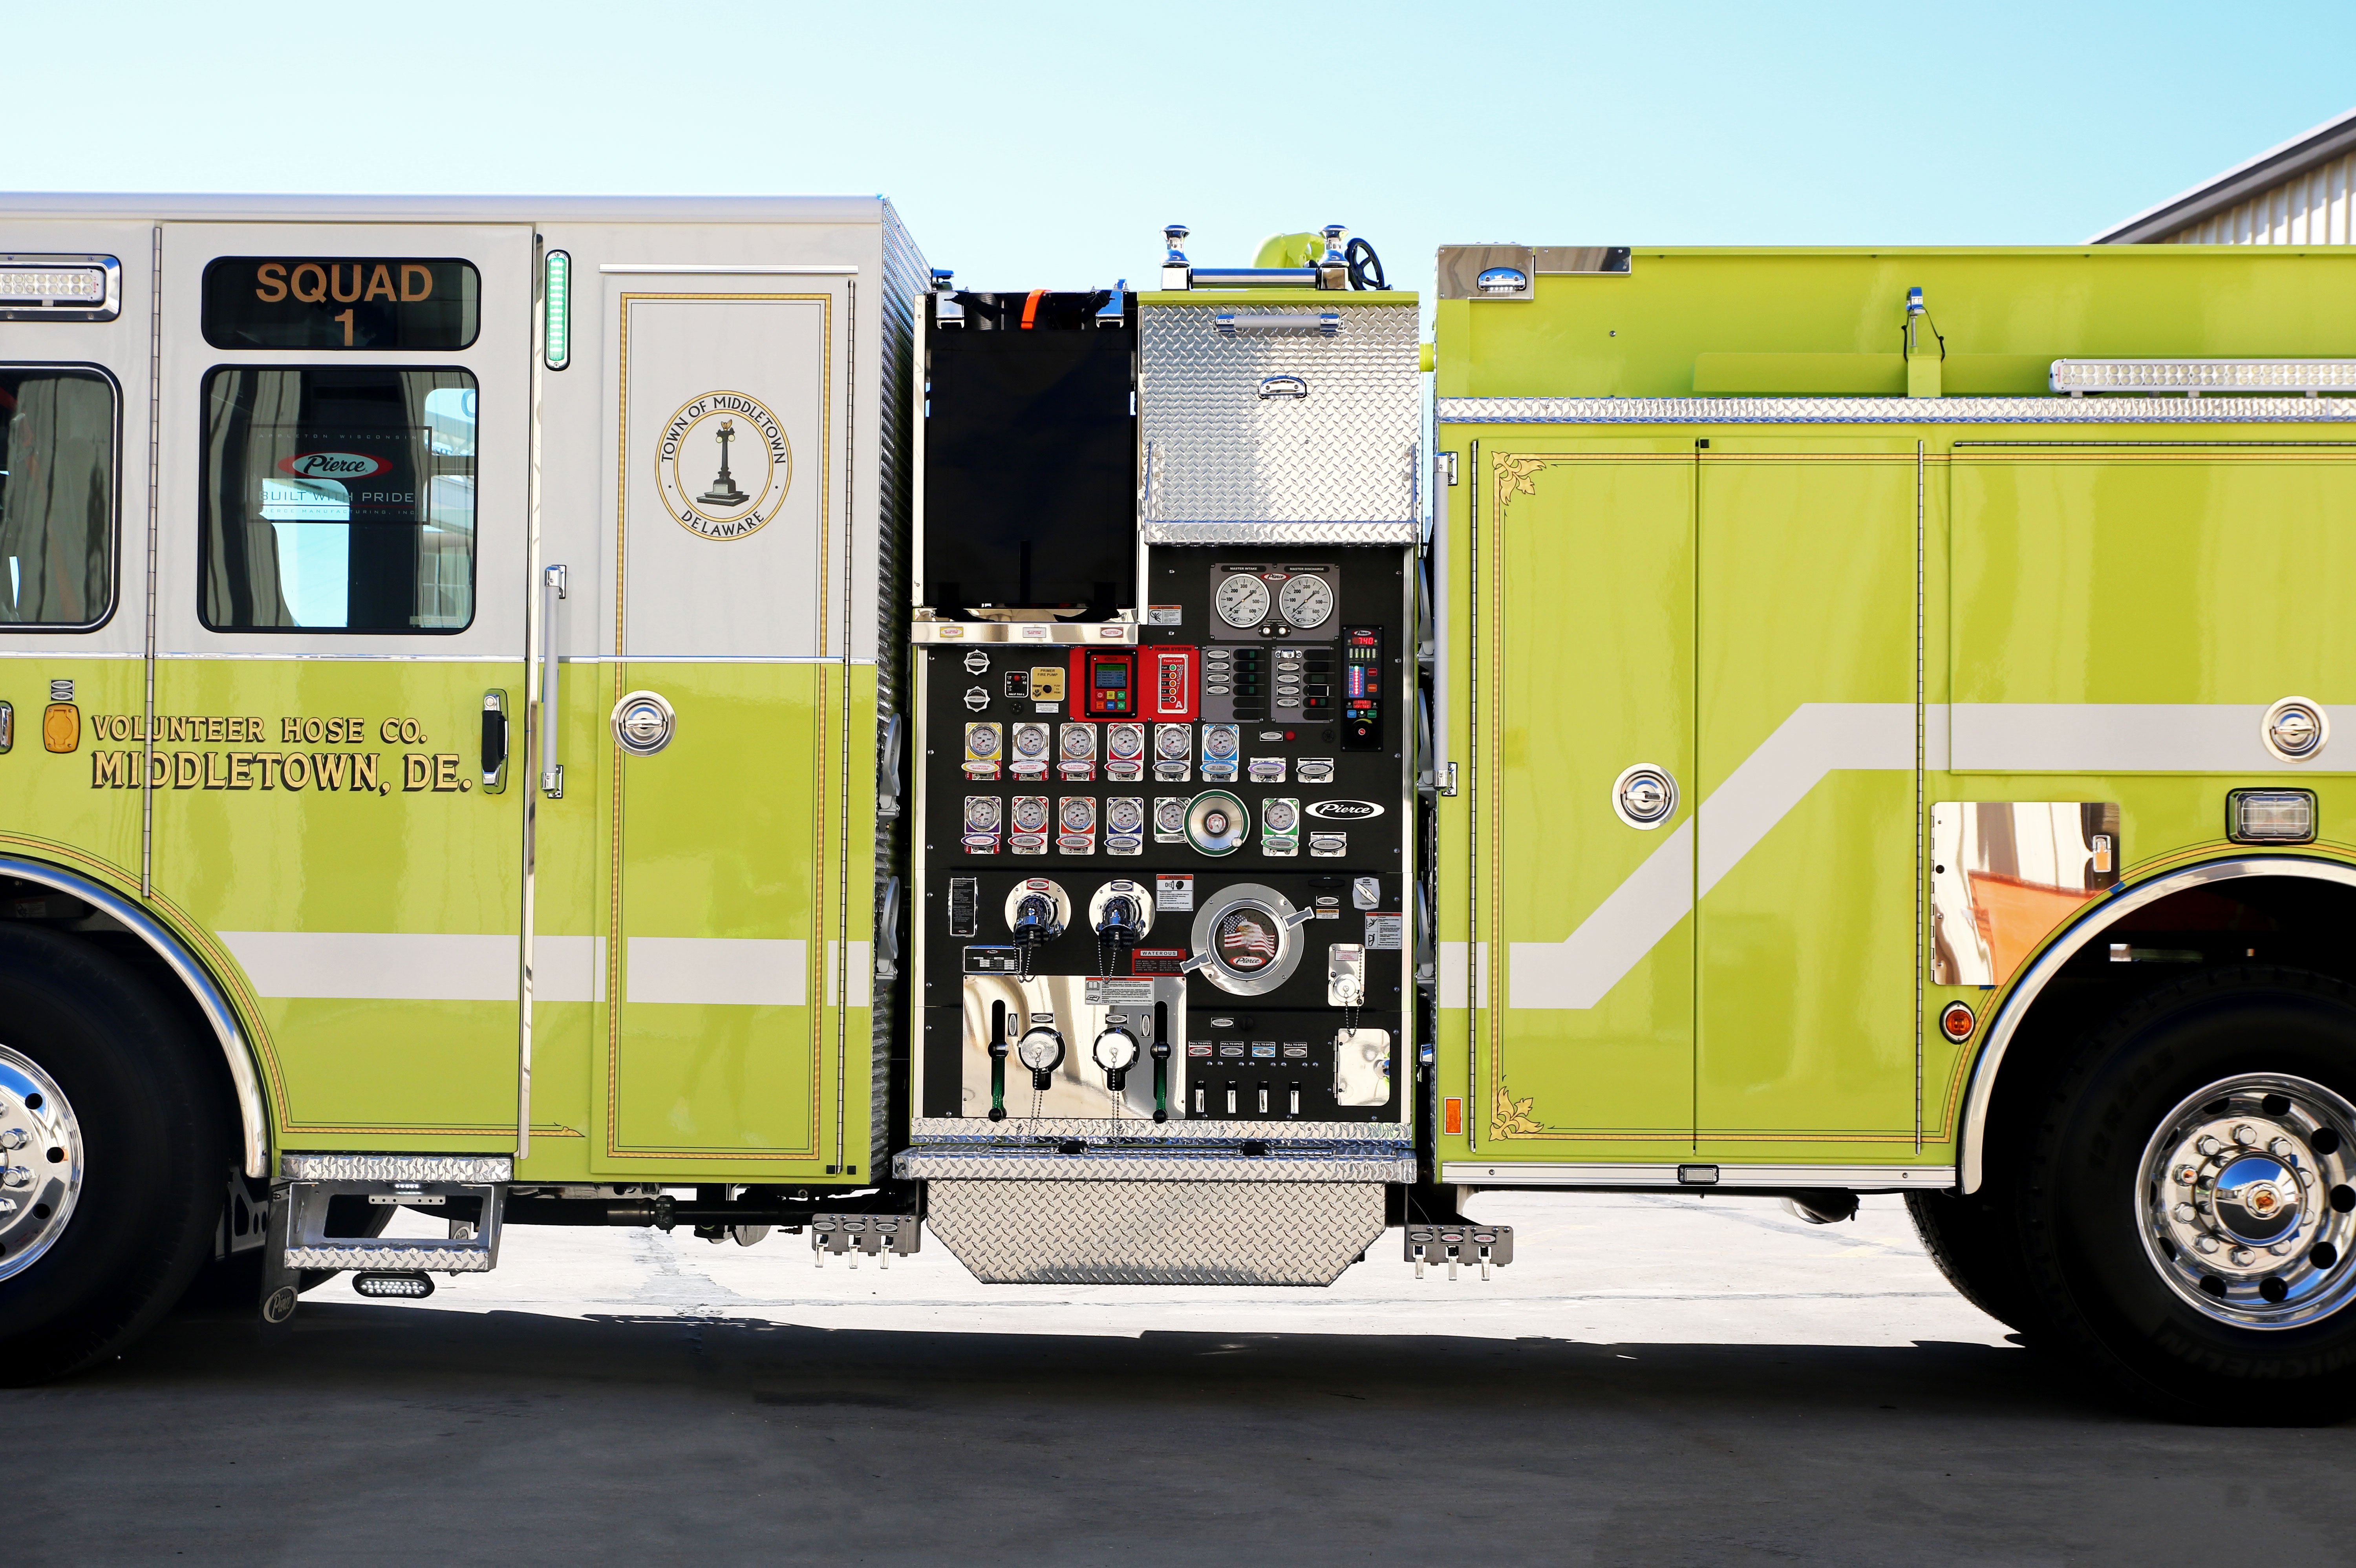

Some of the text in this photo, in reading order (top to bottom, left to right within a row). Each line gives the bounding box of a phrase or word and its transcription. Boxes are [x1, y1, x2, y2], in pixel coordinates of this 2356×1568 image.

[255, 263, 434, 303] SQUAD
[335, 309, 355, 347] 1
[661, 396, 787, 464] TOWN OF MIDDLETOWN
[304, 454, 367, 474] Pierce
[259, 491, 415, 503] BUILT WITH PRIDE
[681, 510, 765, 537] DELAWARE
[90, 715, 428, 744] VOLUNTEER HOSE CO.
[90, 750, 473, 797] MIDDLETOWN, DE.
[1319, 804, 1371, 814] Pierce
